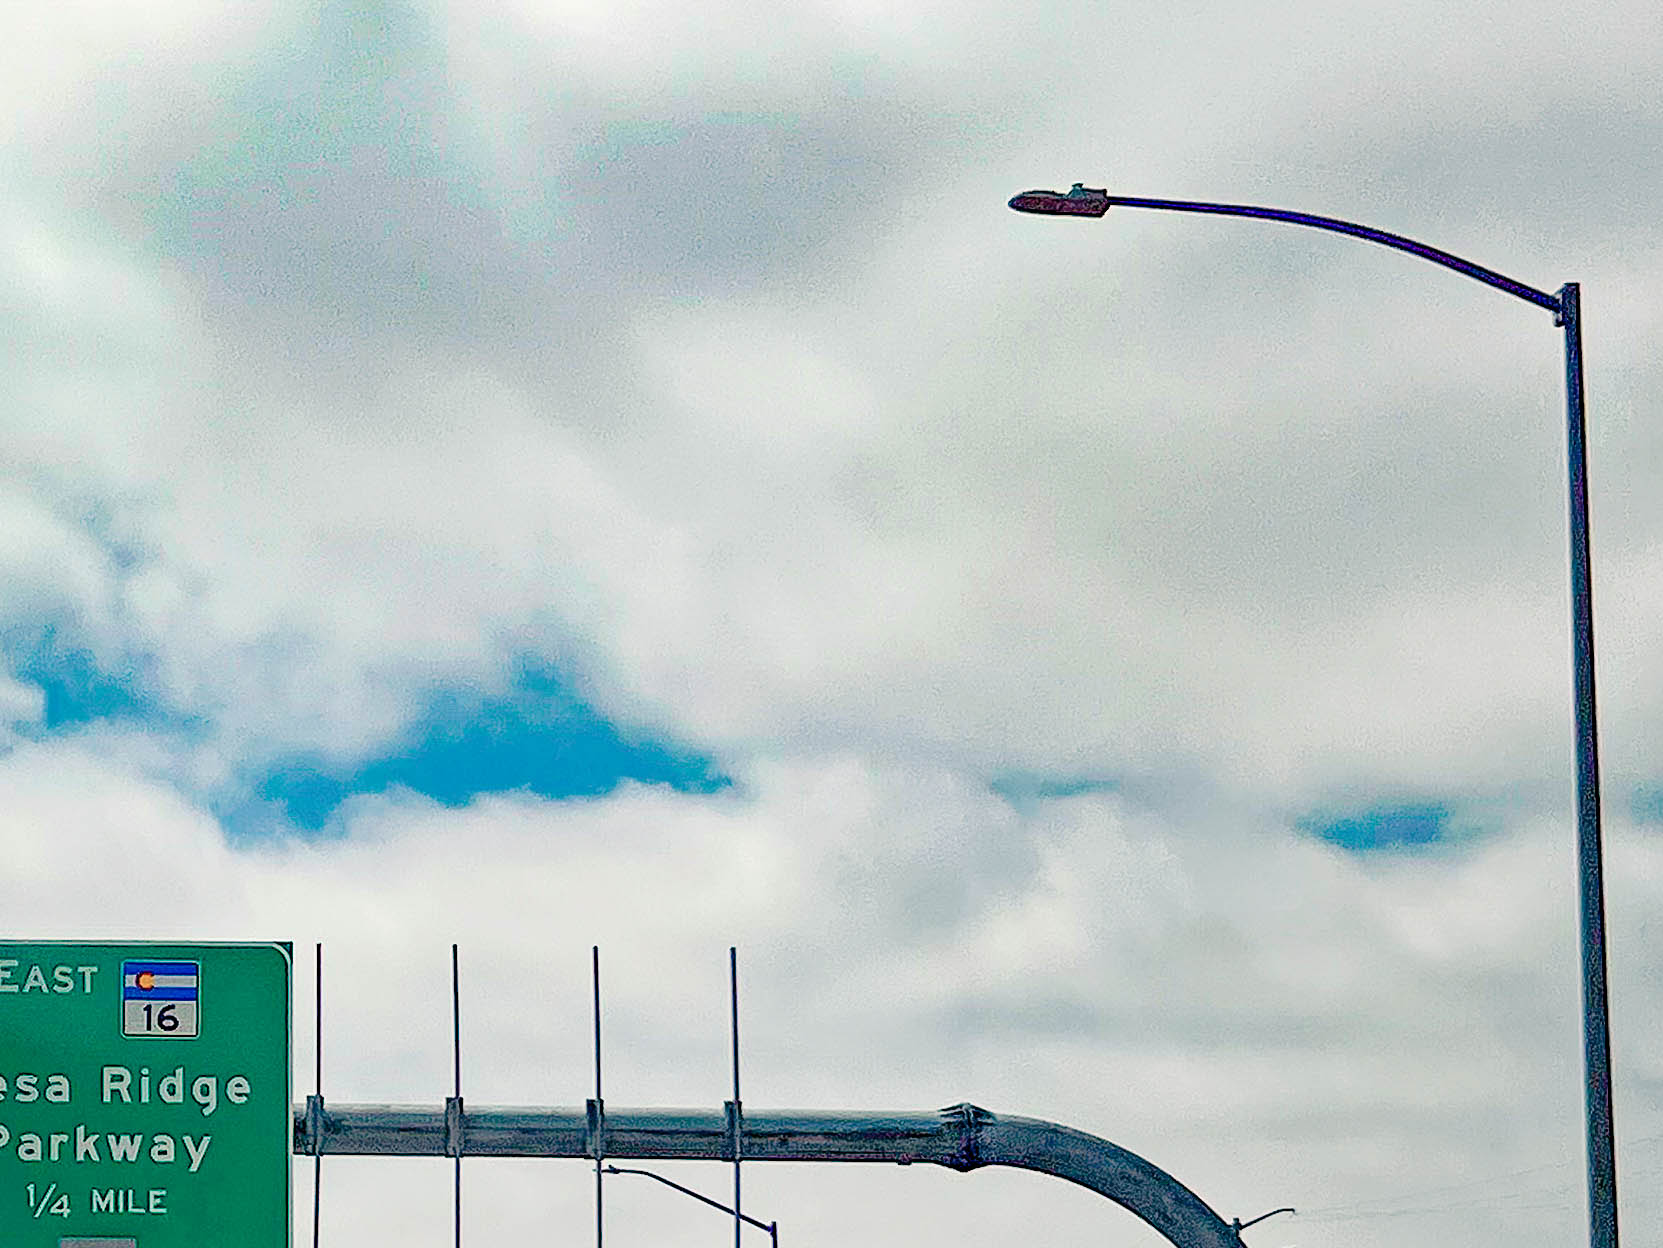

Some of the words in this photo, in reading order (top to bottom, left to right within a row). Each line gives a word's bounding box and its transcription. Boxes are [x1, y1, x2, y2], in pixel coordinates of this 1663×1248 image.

[141, 1003, 180, 1032] 16
[101, 1066, 252, 1117] Ridge
[91, 1188, 168, 1215] MILE
